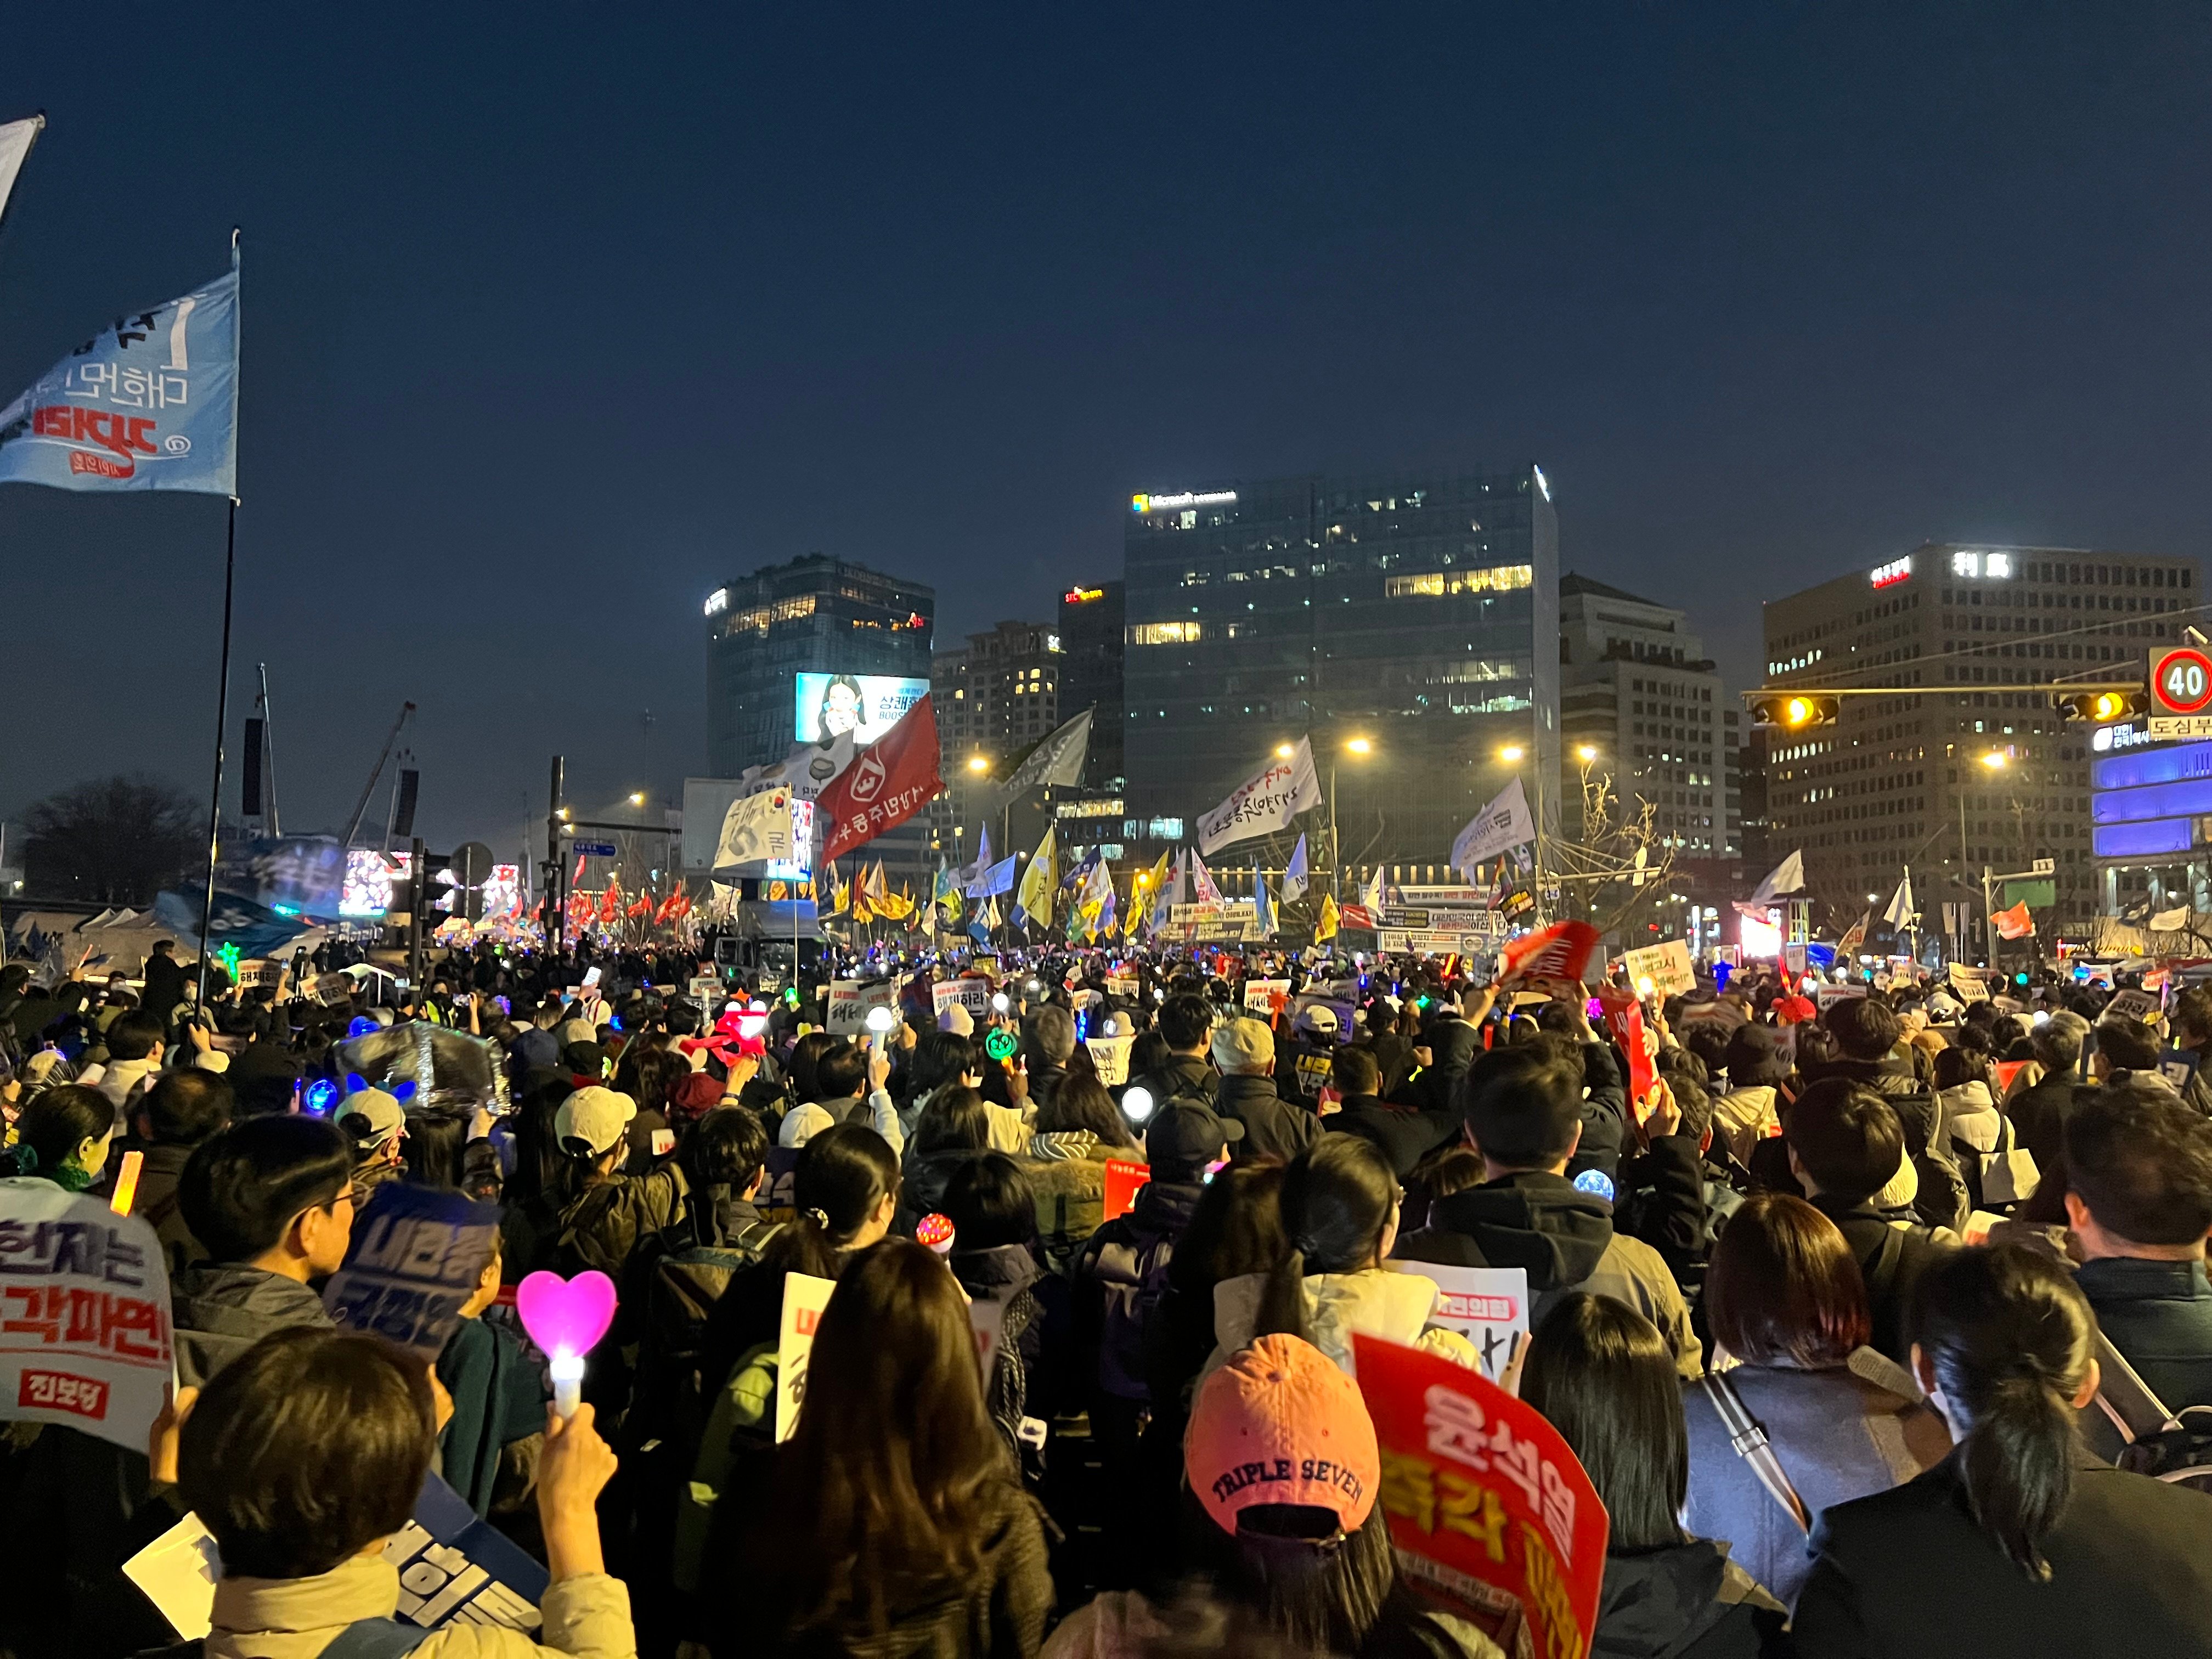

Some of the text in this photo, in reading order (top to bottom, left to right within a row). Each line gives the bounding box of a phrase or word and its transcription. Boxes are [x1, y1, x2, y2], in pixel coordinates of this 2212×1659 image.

[2168, 666, 2202, 695] 40
[0, 1218, 144, 1286] 헌재는
[29, 1374, 101, 1412] 진보당
[1212, 1458, 1363, 1505] TRIPLE SEVEN
[1424, 1384, 1576, 1570] 윤석열
